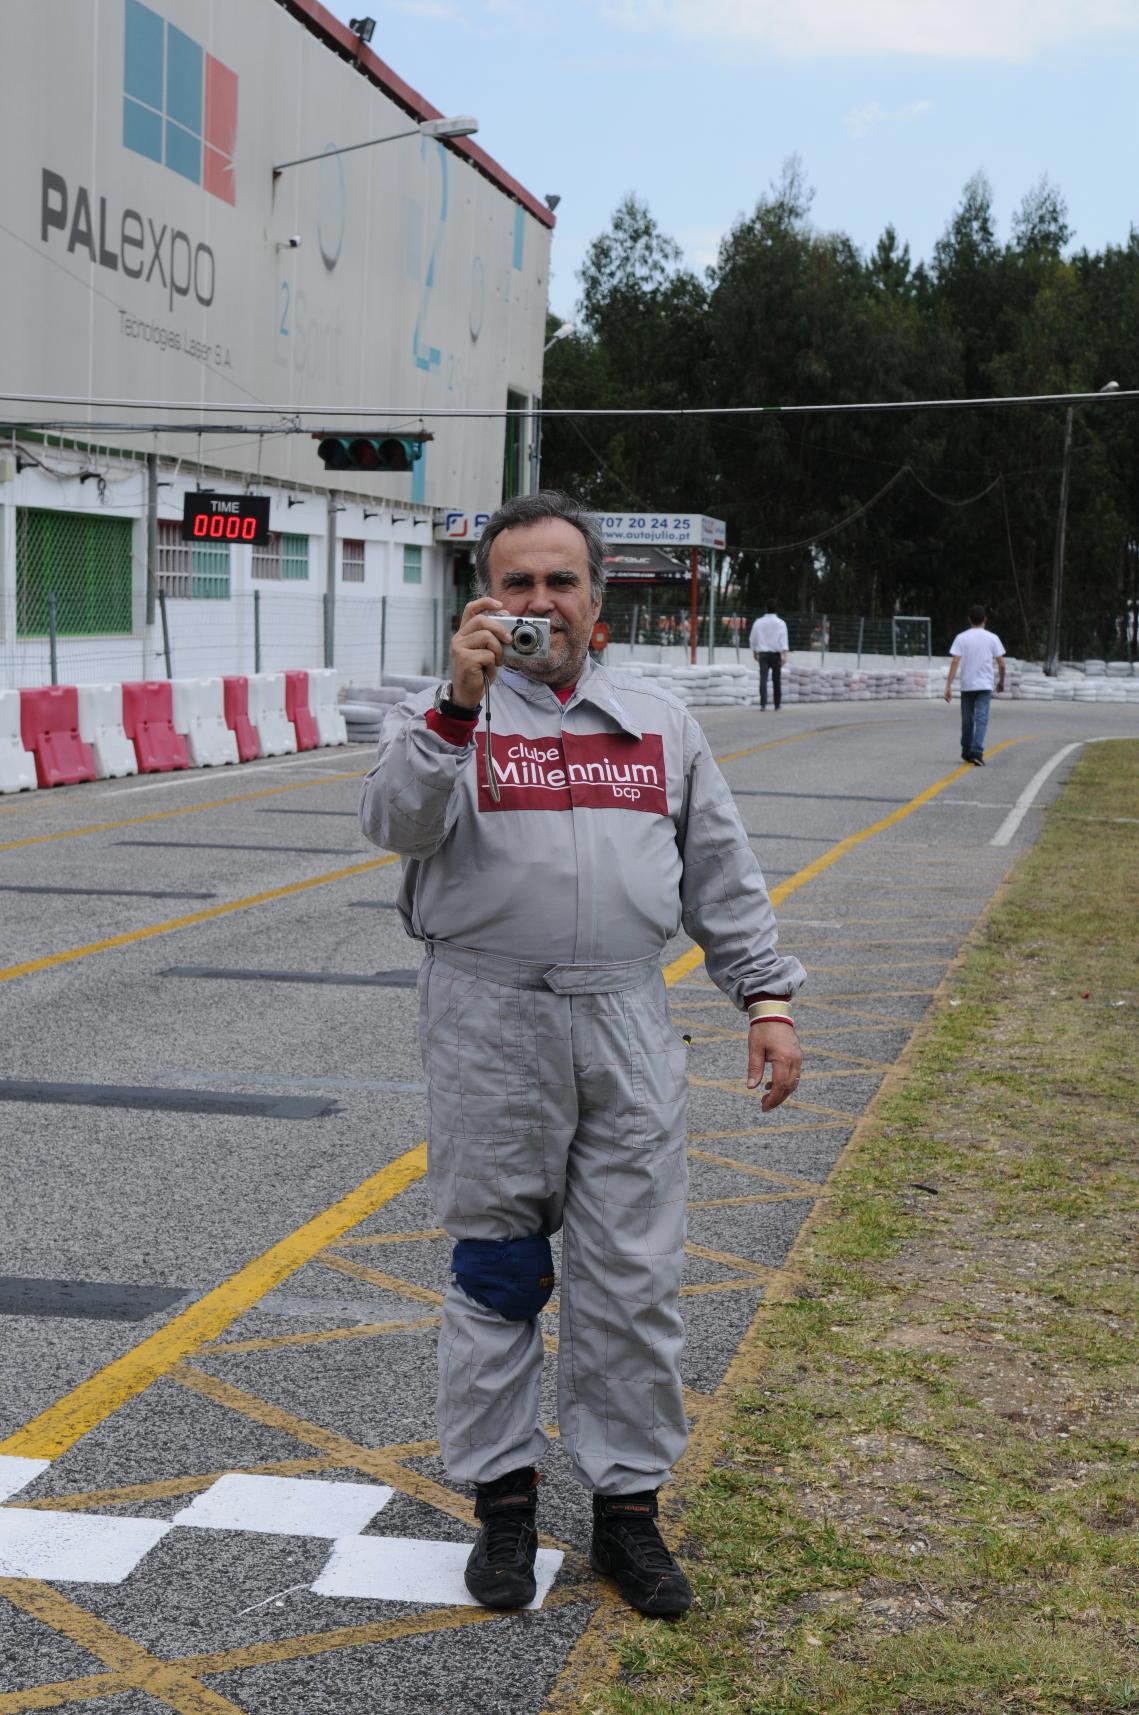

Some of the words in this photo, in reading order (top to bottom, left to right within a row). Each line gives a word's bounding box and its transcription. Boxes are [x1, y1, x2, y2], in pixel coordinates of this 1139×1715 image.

[40, 167, 216, 311] PALexpo
[210, 501, 240, 513] TIME
[193, 514, 257, 539] 0000
[599, 517, 623, 529] 707
[629, 518, 645, 529] 20
[651, 518, 668, 529] 24
[674, 519, 691, 530] 25
[508, 743, 560, 763] clube
[485, 757, 658, 787] Millennium
[613, 785, 641, 801] bcp
